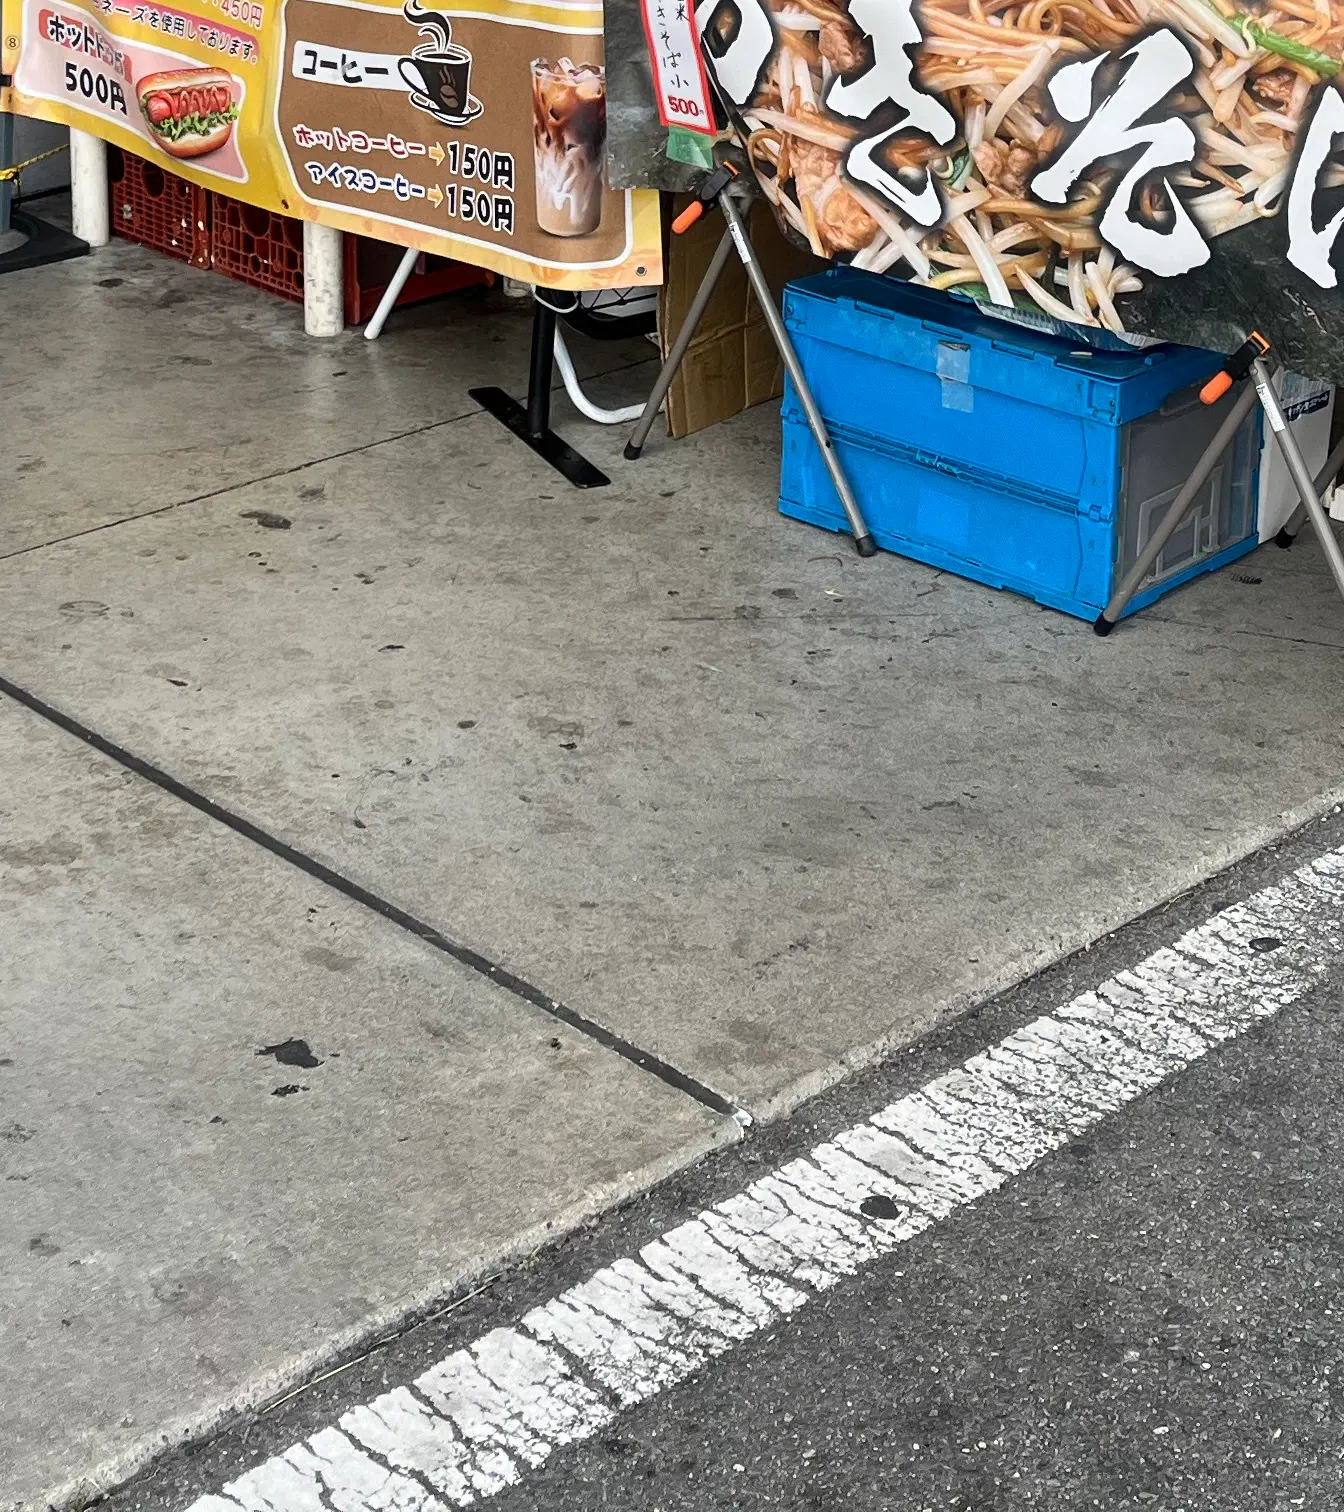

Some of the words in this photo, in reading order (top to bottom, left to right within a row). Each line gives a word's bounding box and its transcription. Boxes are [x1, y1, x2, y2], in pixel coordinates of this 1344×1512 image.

[65, 62, 128, 116] 500円
[303, 50, 389, 84] コーヒー
[294, 125, 425, 157] ホットコーヒー
[448, 142, 515, 192] 150円
[307, 162, 425, 199] アイスコーヒー
[446, 184, 515, 235] 150円
